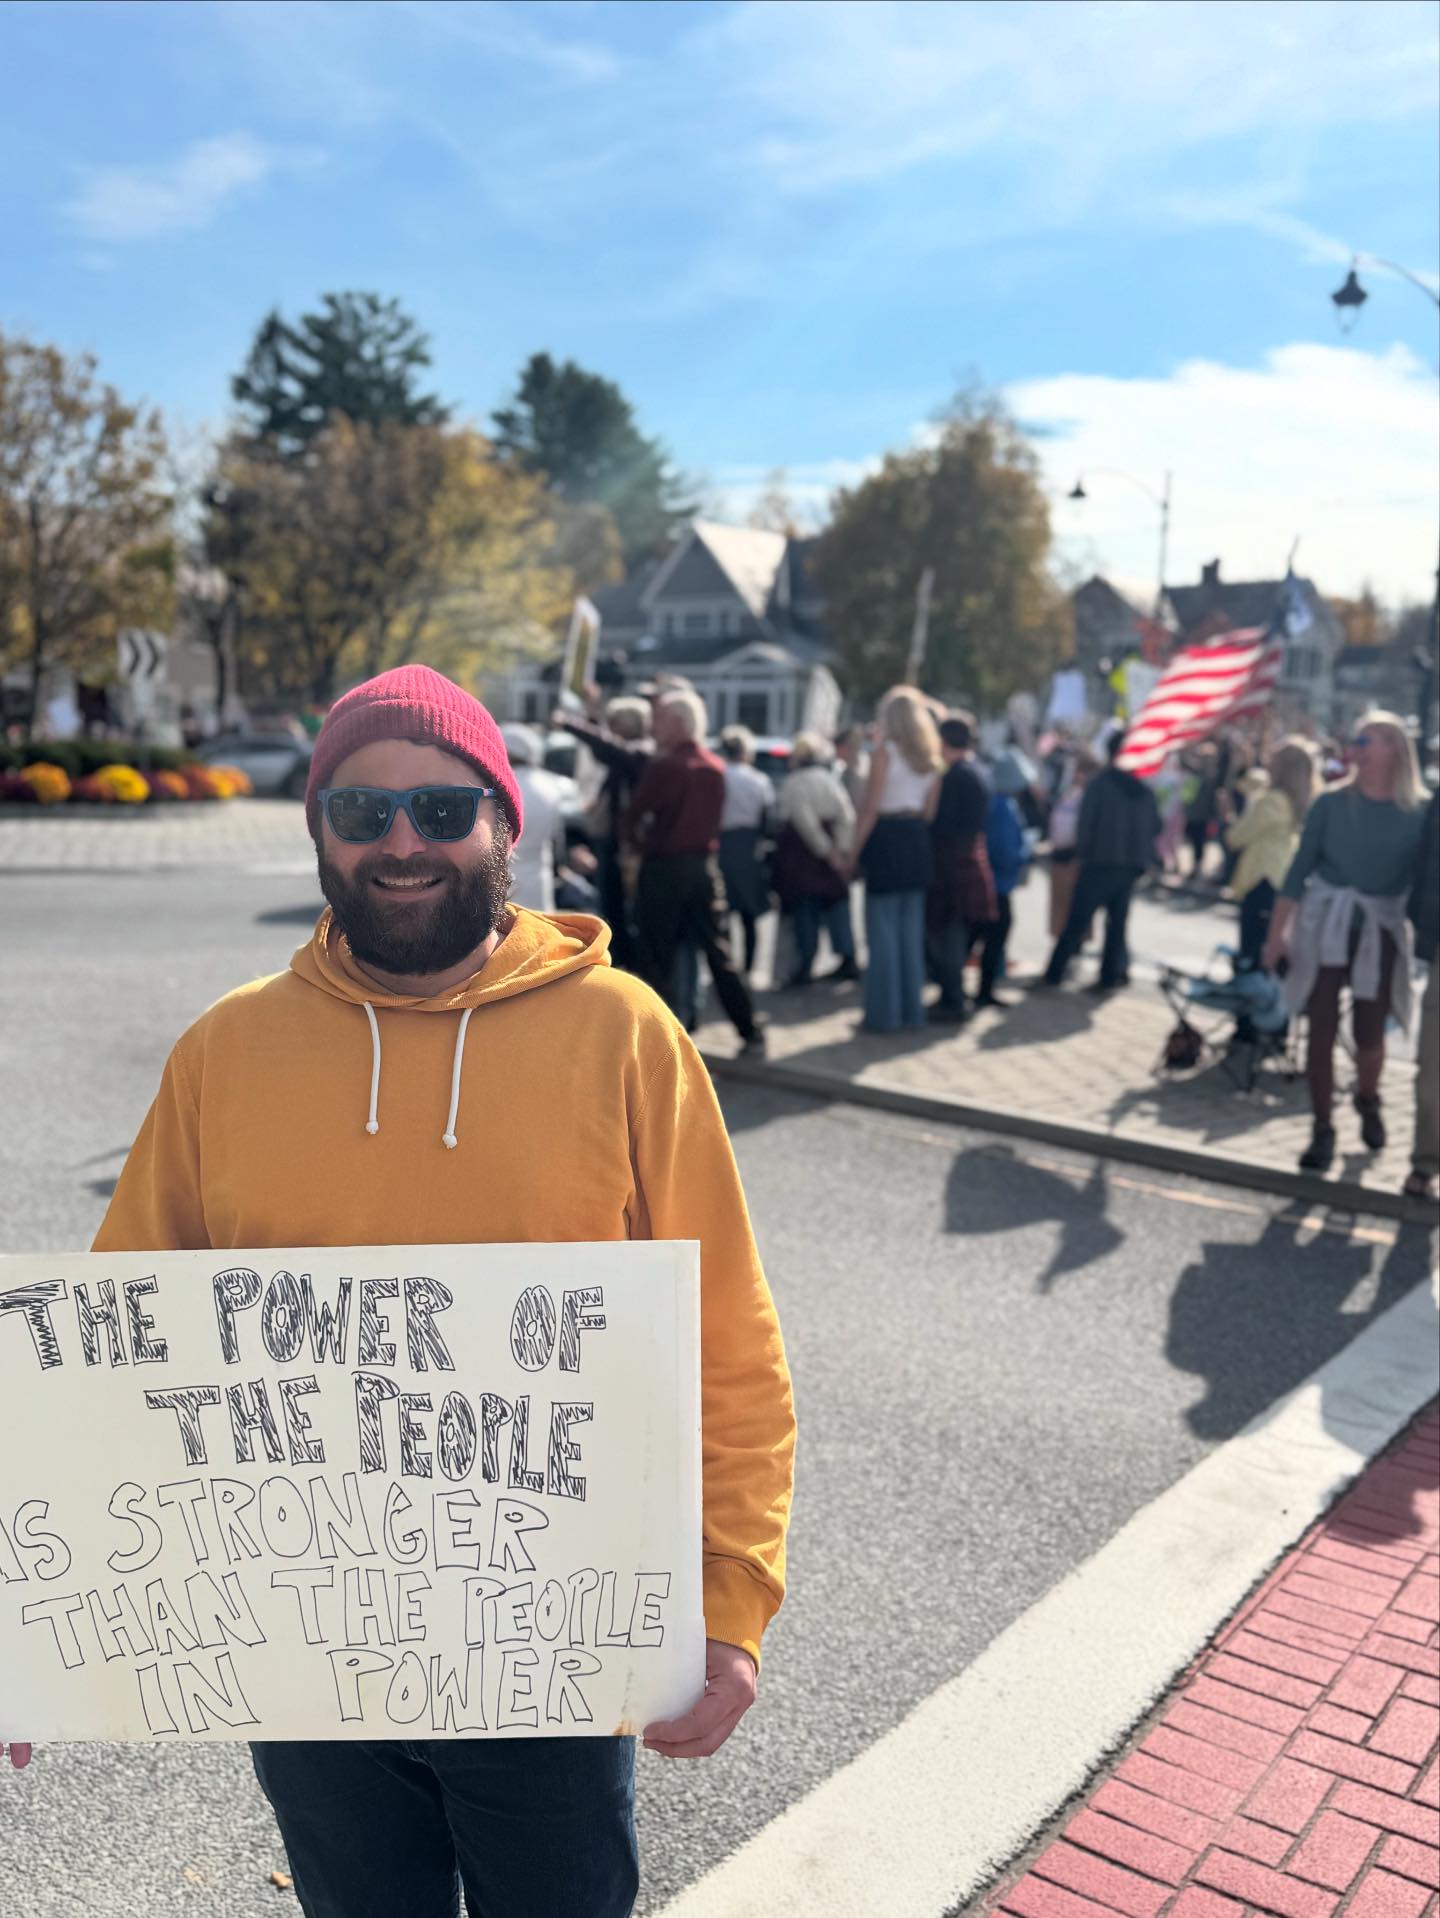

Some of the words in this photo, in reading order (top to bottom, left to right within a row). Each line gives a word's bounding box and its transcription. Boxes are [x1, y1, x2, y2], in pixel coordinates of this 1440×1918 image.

[0, 1275, 169, 1370] THE
[212, 1267, 455, 1372] POWER
[510, 1285, 606, 1373] OF
[145, 1375, 326, 1465] THE
[351, 1371, 594, 1501] PEOPLE
[107, 1473, 549, 1573] STRONGER
[22, 1571, 267, 1669] THAN
[271, 1567, 432, 1645] THE
[463, 1568, 671, 1648] PEOPLE
[136, 1651, 261, 1734] IN
[326, 1647, 602, 1731] POWER
